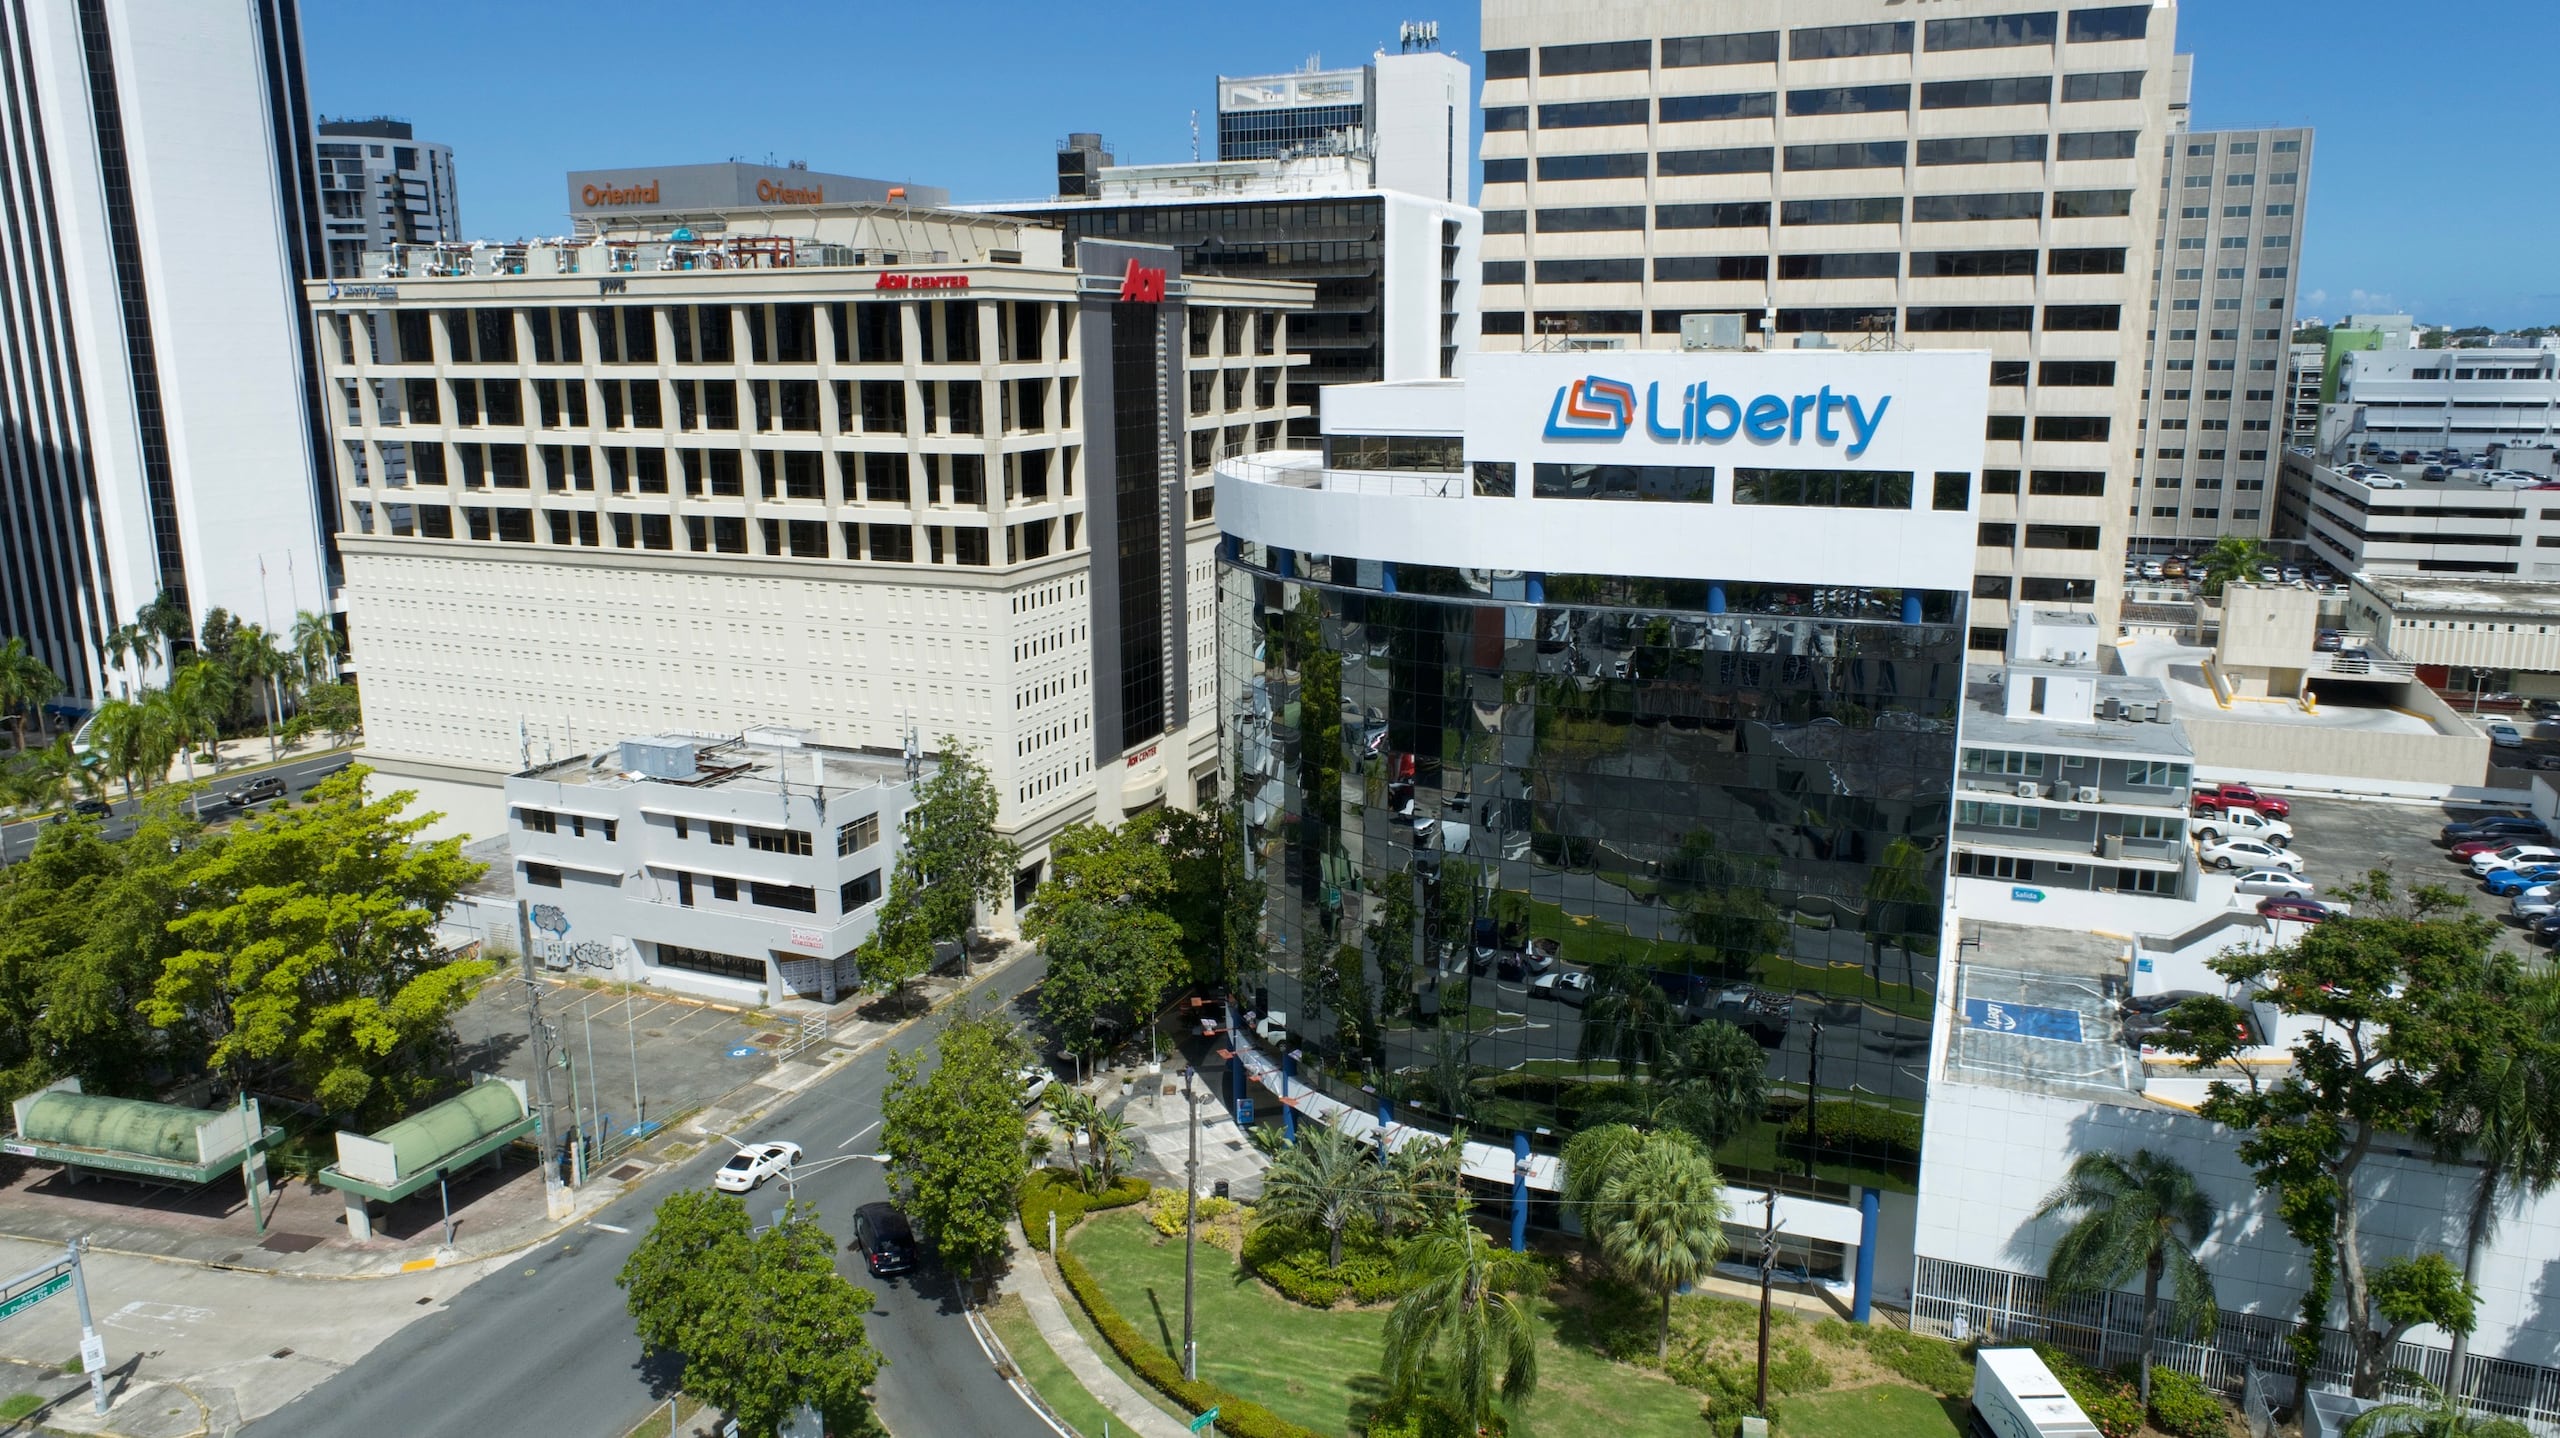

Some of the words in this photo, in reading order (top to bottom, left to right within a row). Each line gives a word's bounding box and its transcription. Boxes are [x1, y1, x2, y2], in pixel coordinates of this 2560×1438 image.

[582, 179, 659, 207] Oriental
[757, 178, 823, 205] Oriental
[911, 275, 969, 290] CENTER
[1120, 257, 1166, 303] AON
[1647, 380, 1892, 457] Liberty
[2015, 891, 2038, 900] Salida
[10, 1298, 33, 1313] Ponce
[38, 1292, 48, 1300] De
[21, 1286, 48, 1302] Avenida
